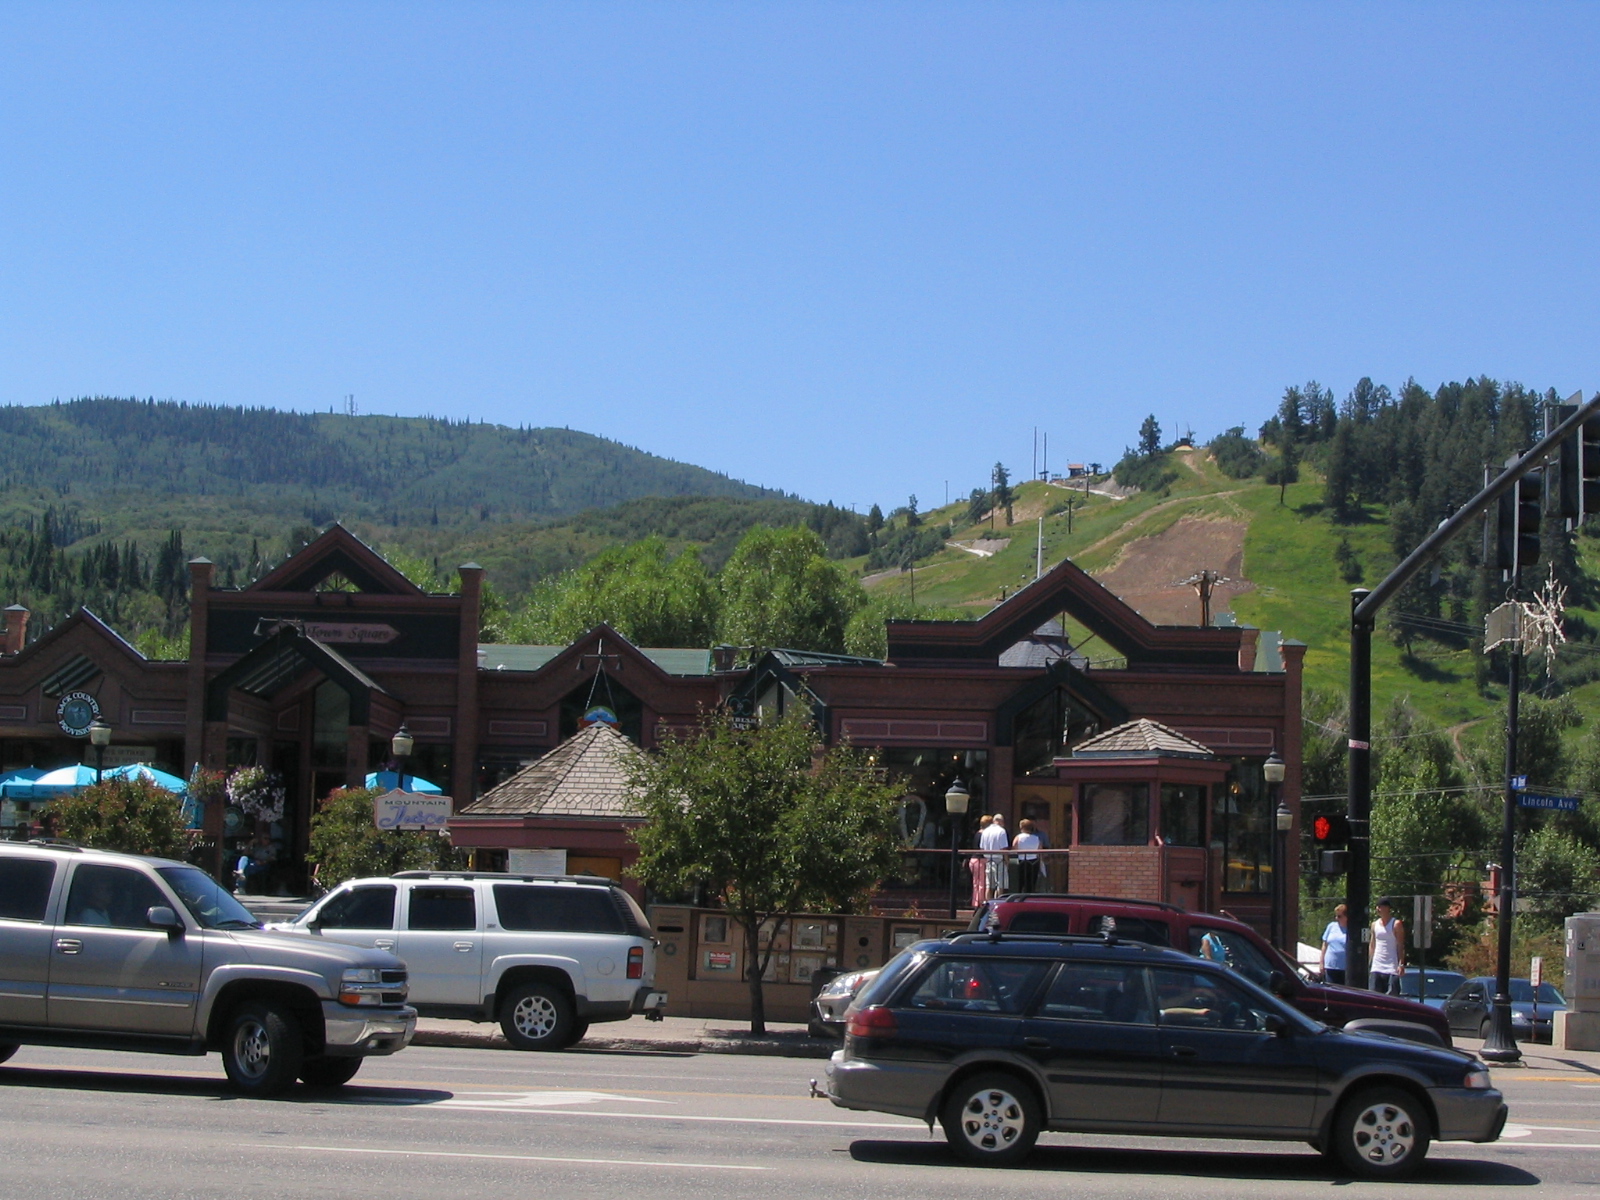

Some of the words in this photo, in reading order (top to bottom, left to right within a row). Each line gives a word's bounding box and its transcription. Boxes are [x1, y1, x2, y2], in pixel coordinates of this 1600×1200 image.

[348, 626, 390, 642] Square
[57, 695, 73, 714] BACK
[72, 691, 100, 714] COUNTRY
[1522, 796, 1554, 807] Lincoln
